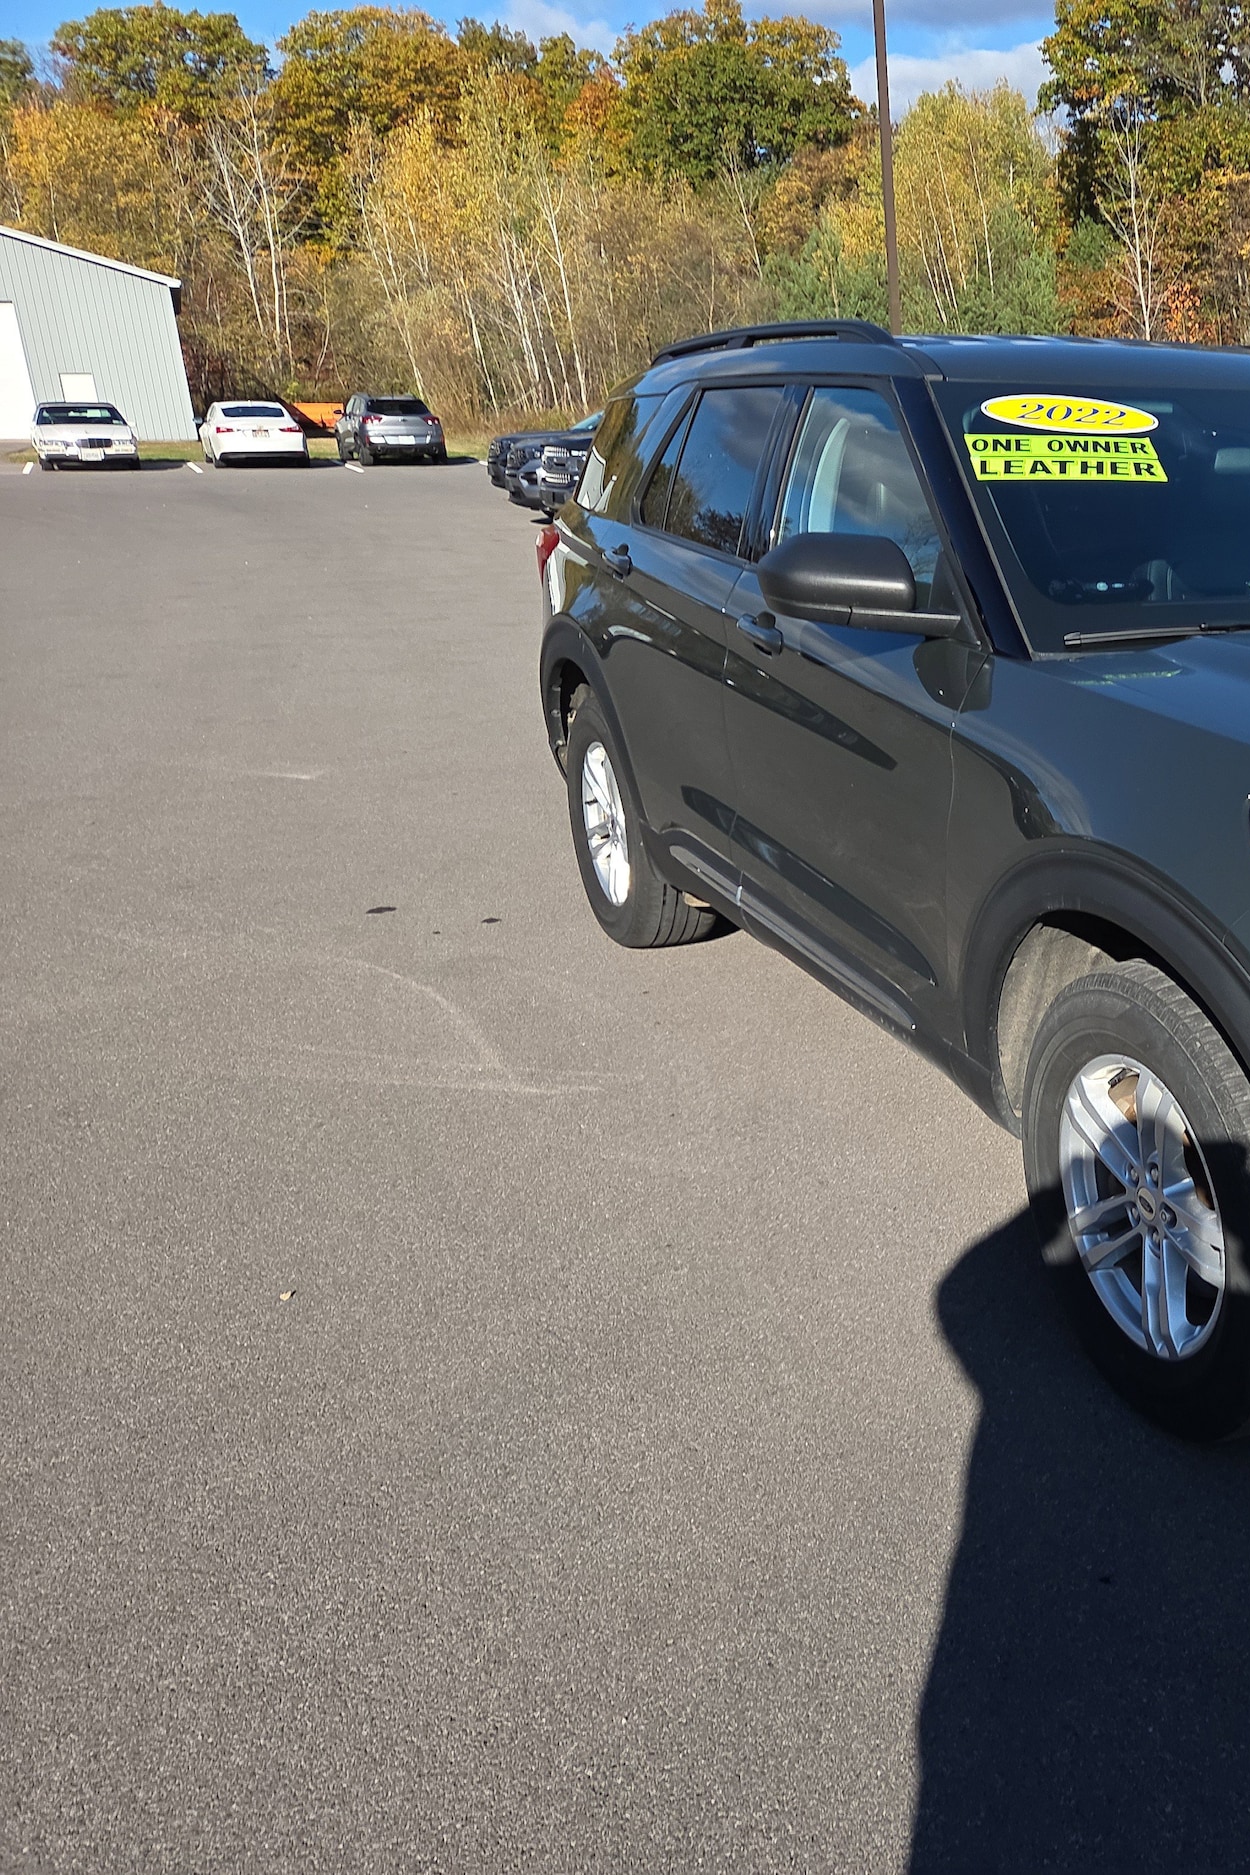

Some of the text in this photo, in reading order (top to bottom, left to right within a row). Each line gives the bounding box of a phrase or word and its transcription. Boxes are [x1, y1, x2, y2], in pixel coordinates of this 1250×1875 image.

[1016, 402, 1128, 426] 2022
[971, 438, 1150, 455] ONE OWNER
[979, 460, 1158, 477] LEATHER
